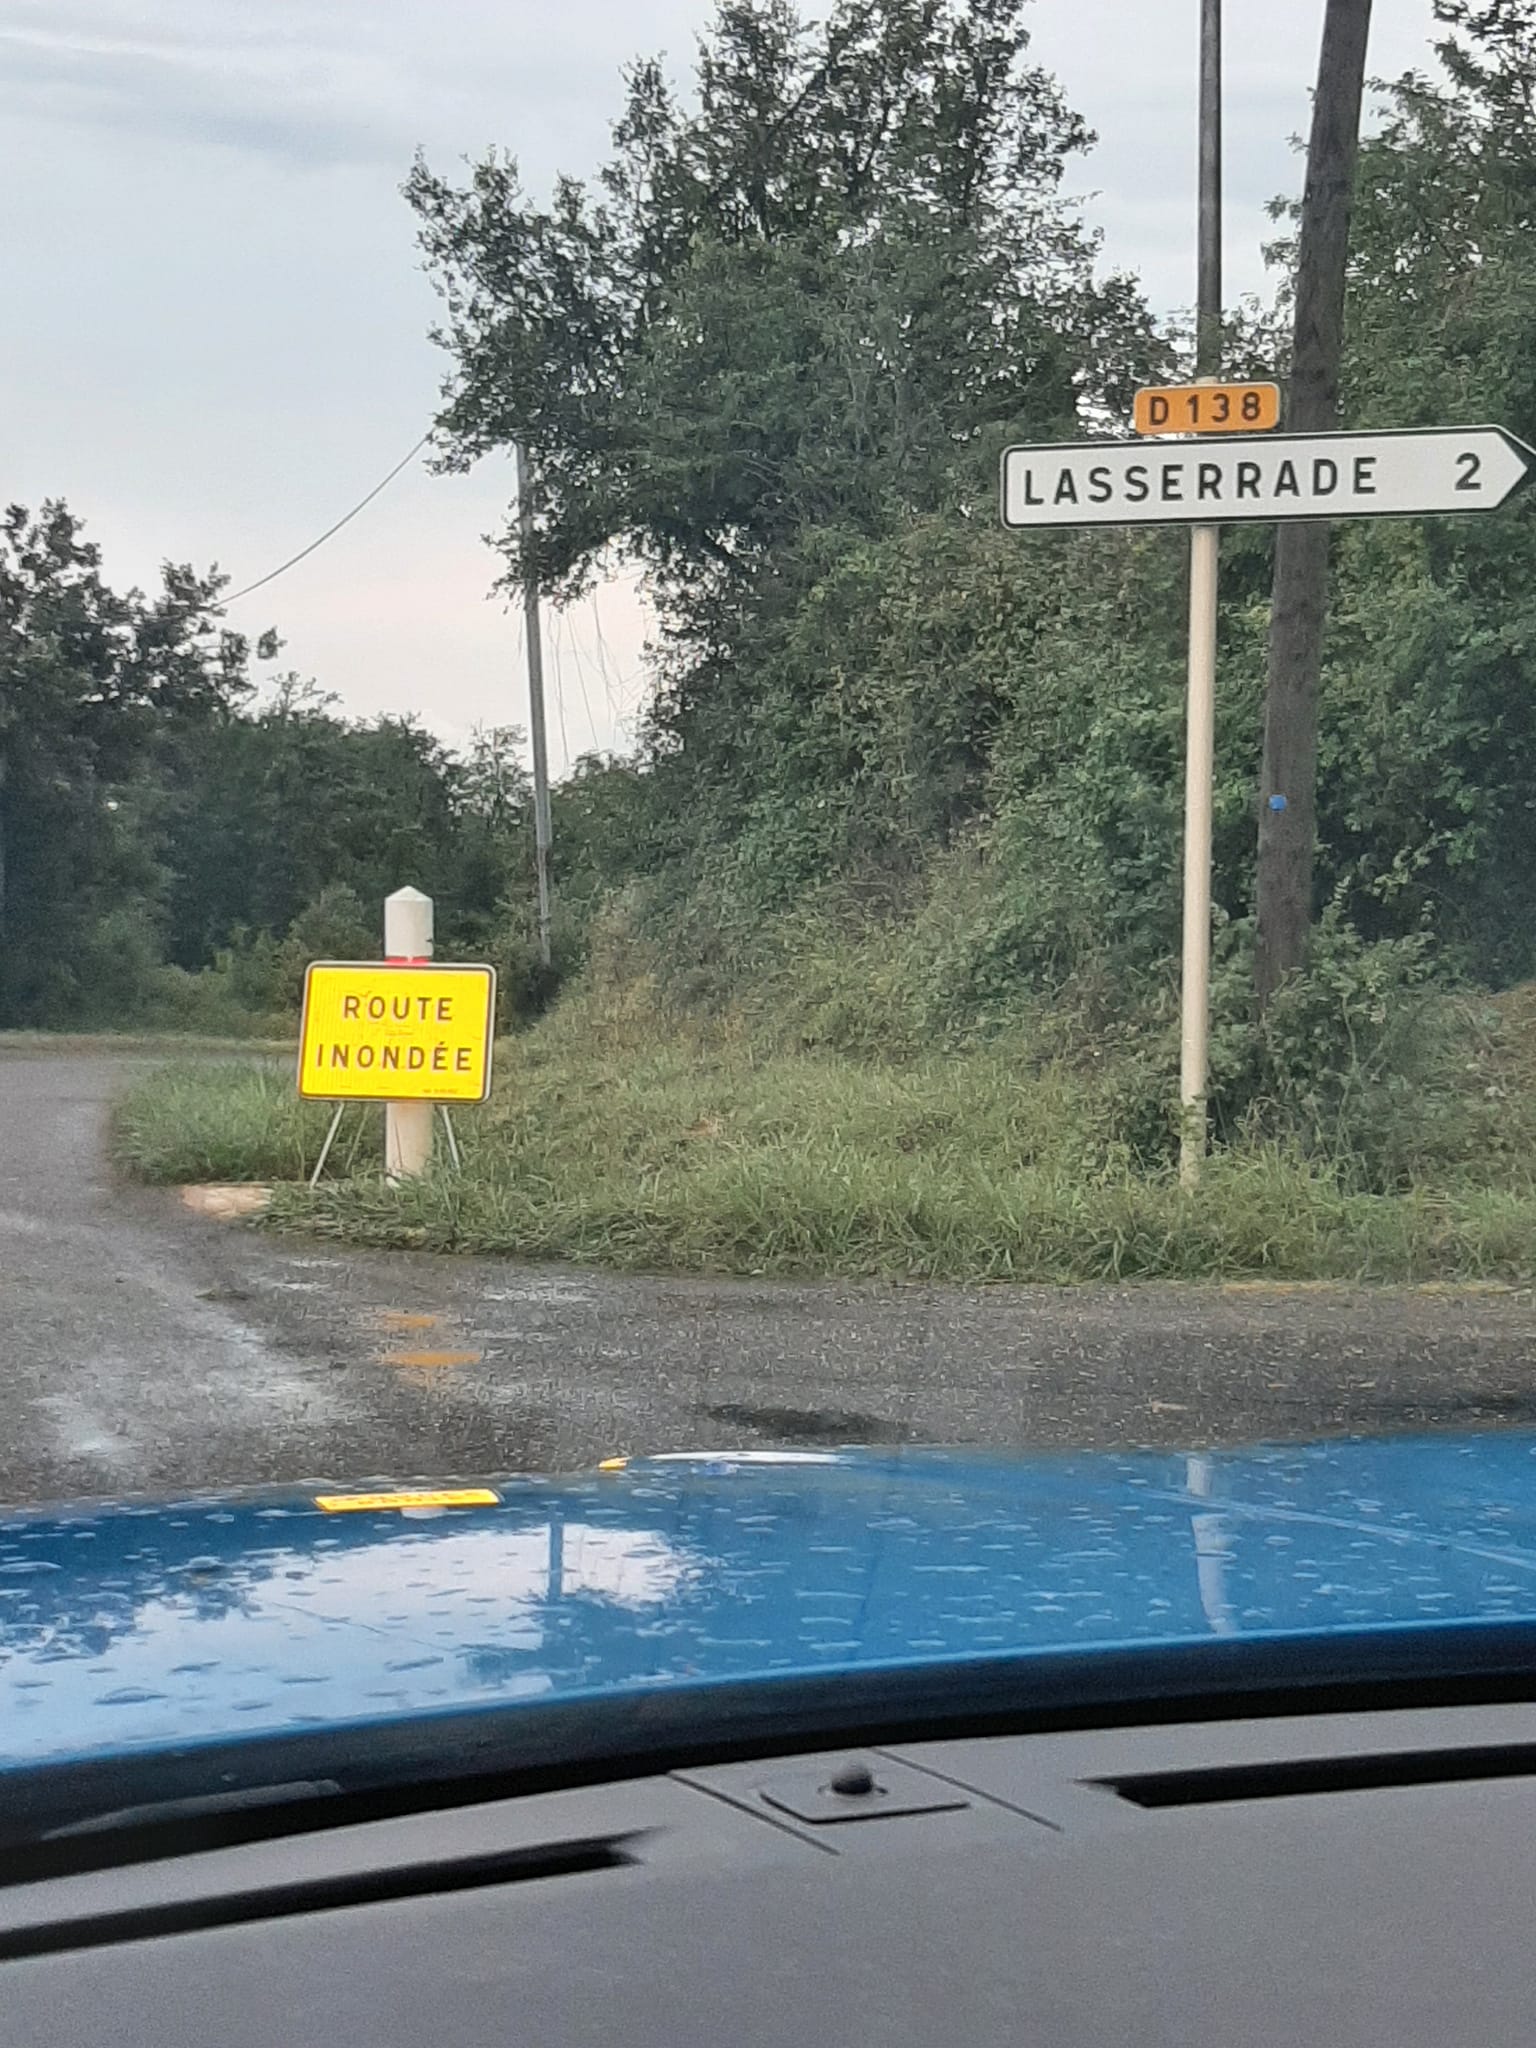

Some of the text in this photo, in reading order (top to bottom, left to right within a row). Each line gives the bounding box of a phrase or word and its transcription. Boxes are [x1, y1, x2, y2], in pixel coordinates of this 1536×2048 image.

[1149, 391, 1262, 426] D 138
[1025, 452, 1482, 506] LASSERRADE 2
[343, 995, 453, 1021] ROUTE
[316, 1041, 472, 1071] INONDÉE
